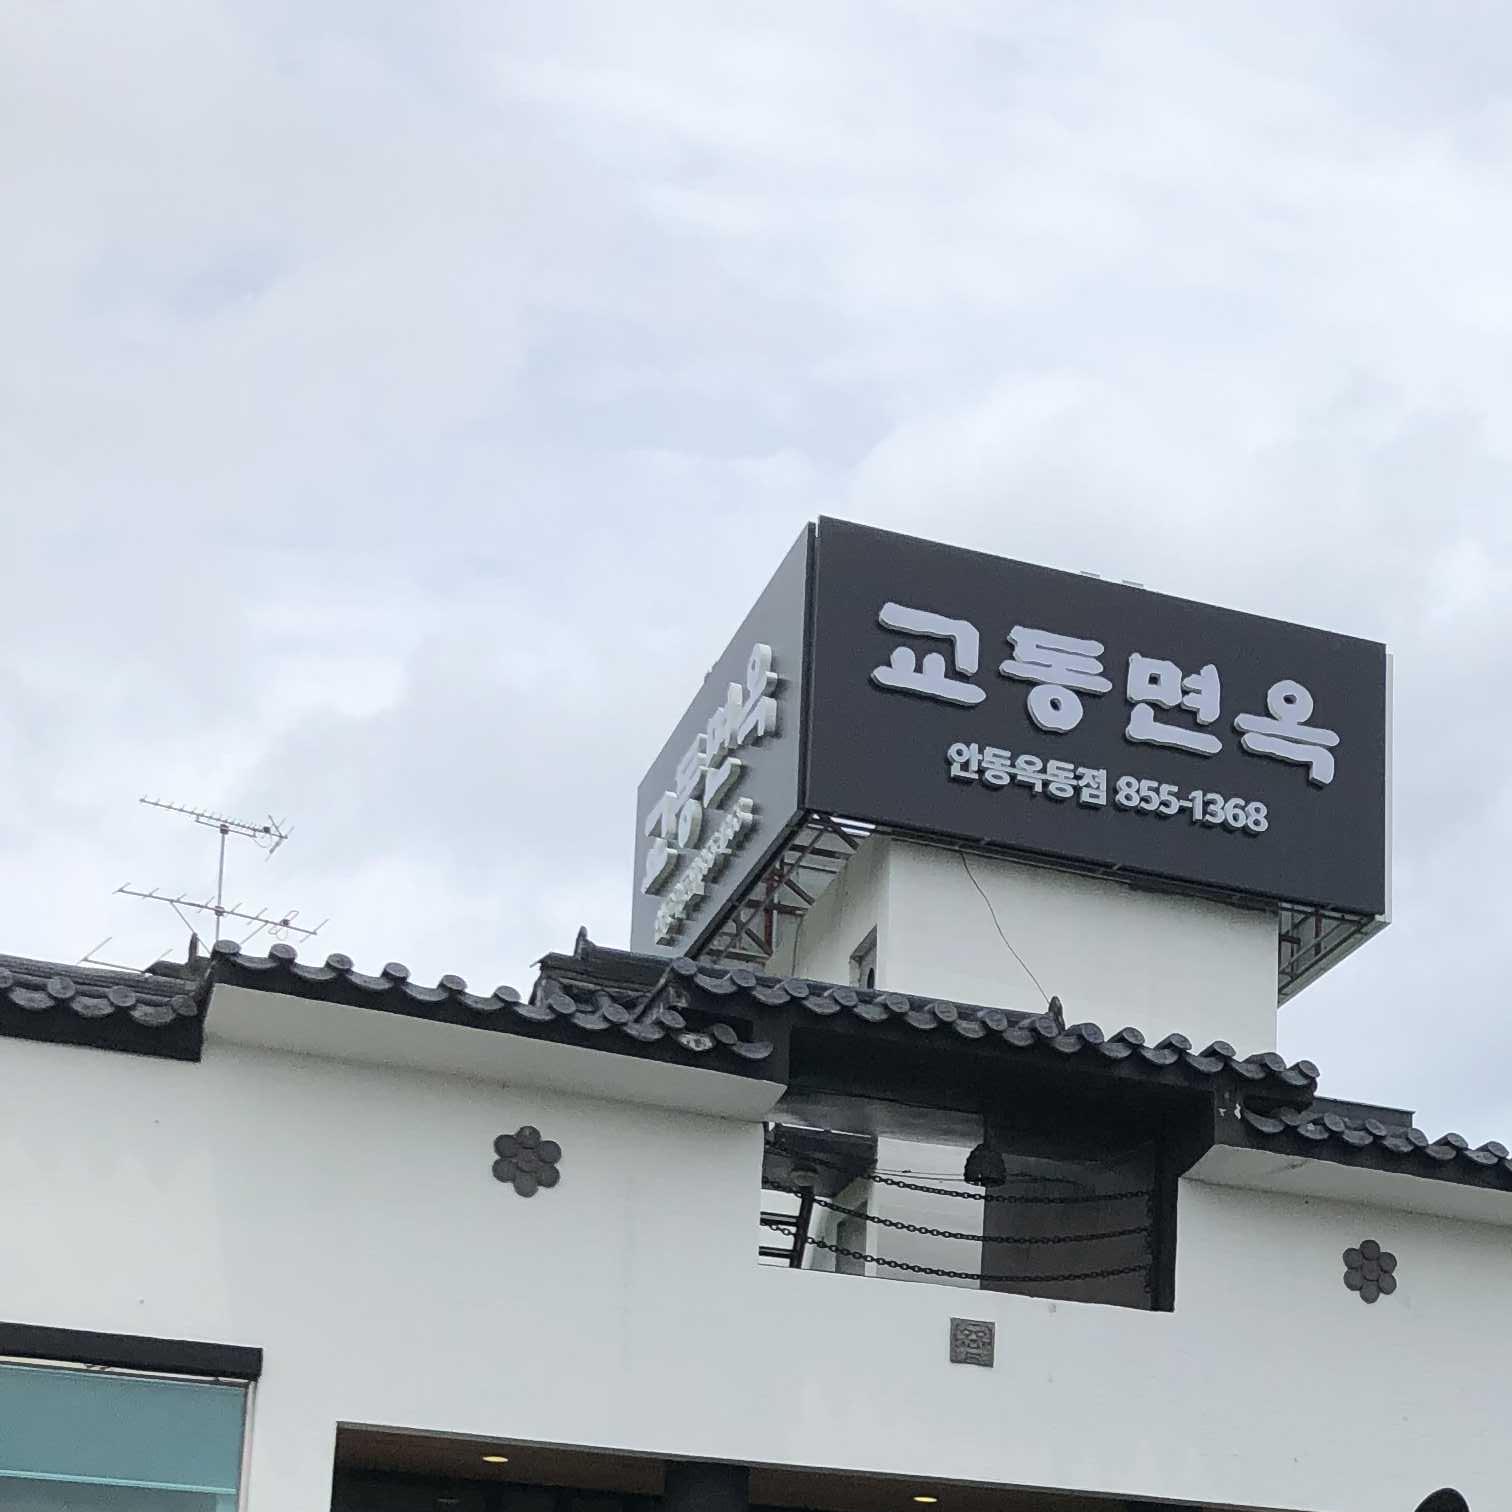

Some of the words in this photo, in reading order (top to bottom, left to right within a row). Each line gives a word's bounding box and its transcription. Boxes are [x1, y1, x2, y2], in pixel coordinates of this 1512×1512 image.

[871, 601, 1340, 787] 교동면옥
[947, 741, 1107, 807] 안동옥동점
[1115, 775, 1269, 833] 855-1368
